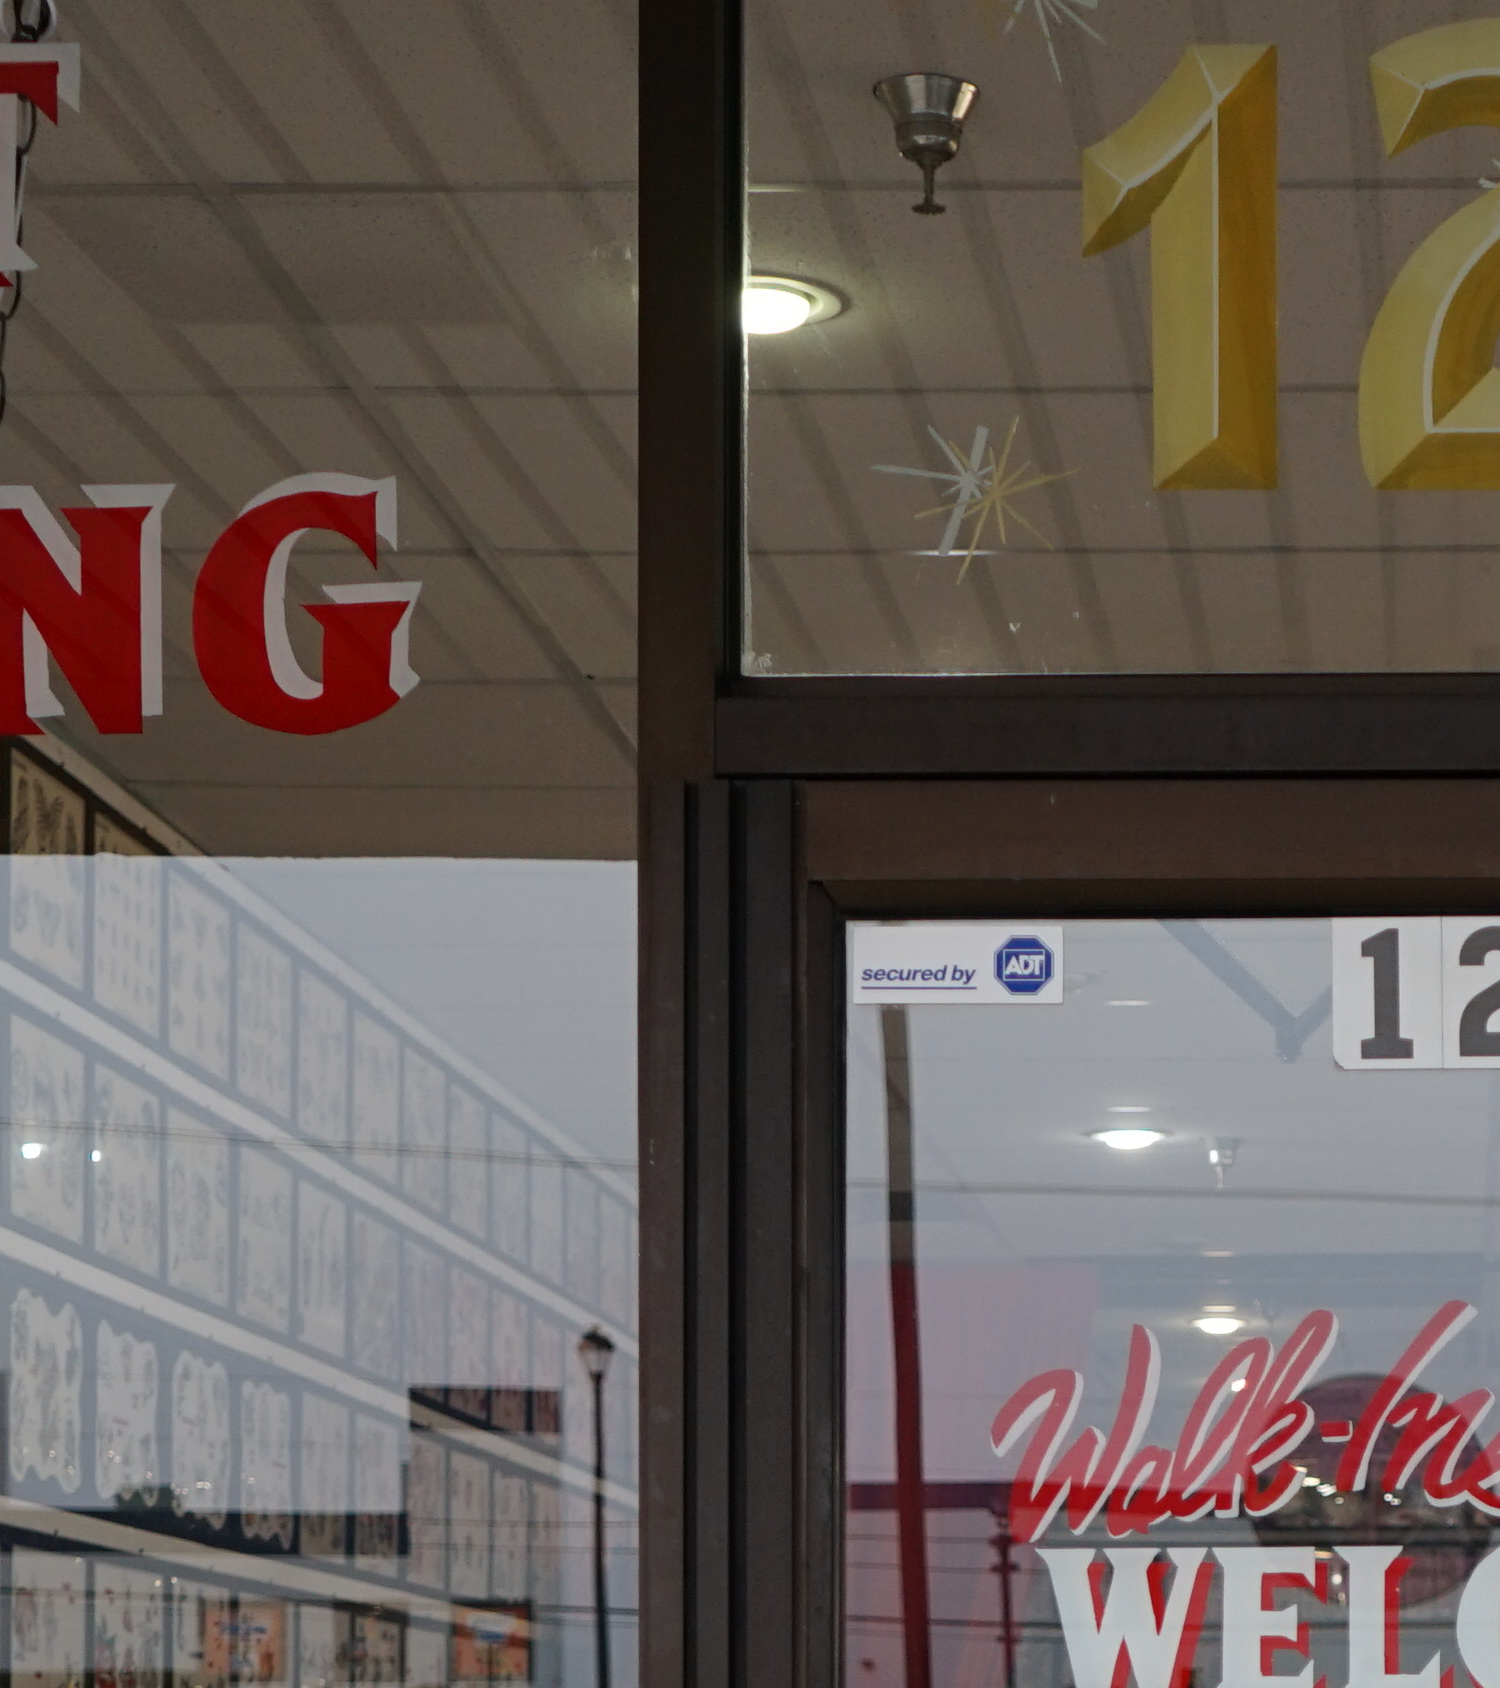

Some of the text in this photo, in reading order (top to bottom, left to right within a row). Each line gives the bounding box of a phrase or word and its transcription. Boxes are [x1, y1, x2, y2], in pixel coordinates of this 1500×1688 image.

[861, 955, 1043, 987] secured by ADT
